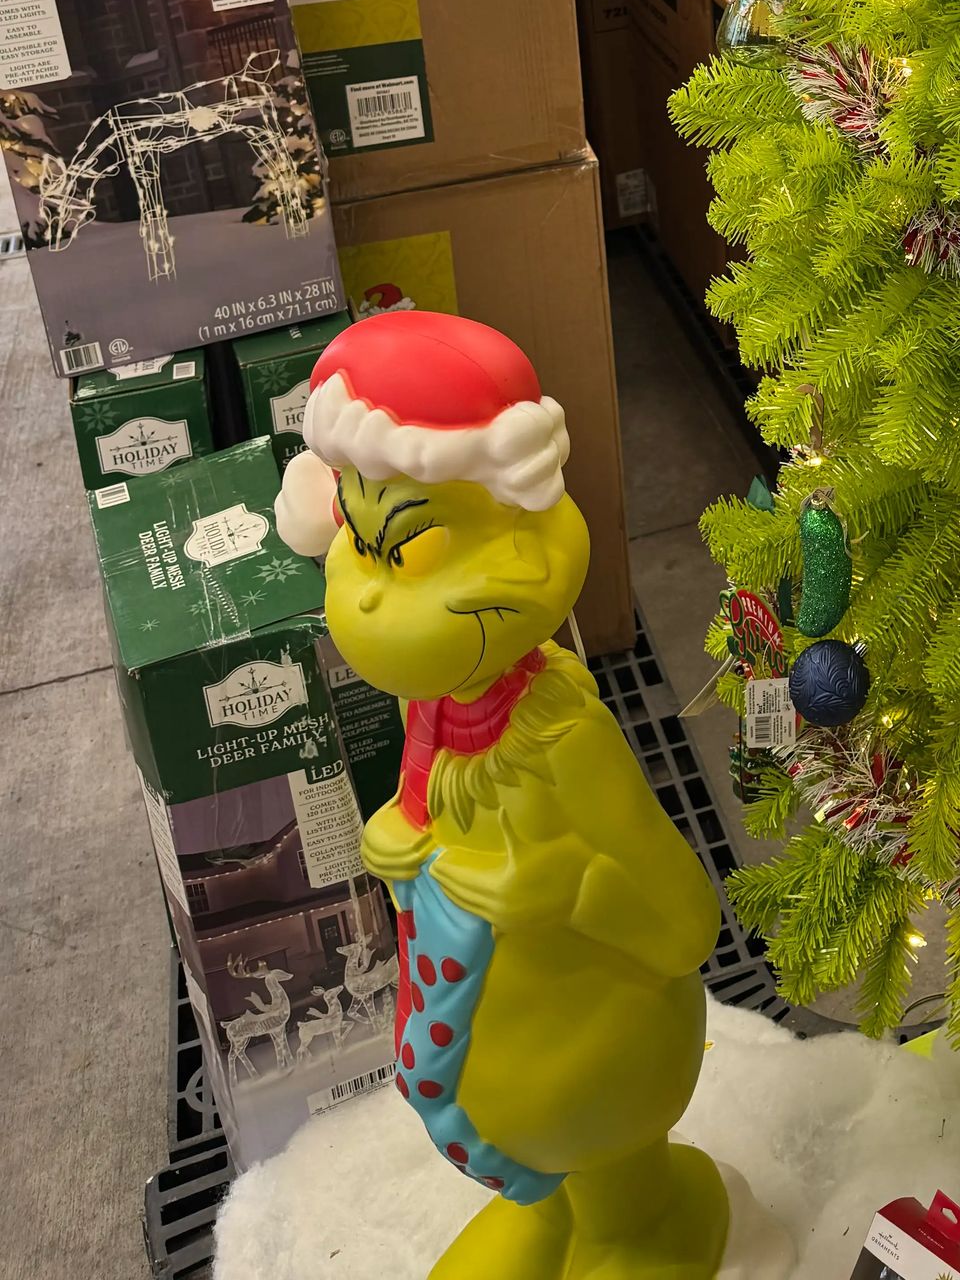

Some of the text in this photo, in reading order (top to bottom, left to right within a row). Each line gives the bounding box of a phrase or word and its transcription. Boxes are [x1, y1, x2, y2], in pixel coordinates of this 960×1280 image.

[20, 10, 46, 18] LIGHTS
[5, 30, 42, 40] ASSEMBLE
[0, 42, 42, 54] OLLAPSIBLE
[1, 47, 54, 60] EASY STORAGE
[5, 65, 59, 79] PRE-ATTACHED
[10, 64, 36, 72] LIGHTS
[36, 72, 59, 81] FRAME
[214, 306, 230, 320] 40
[232, 302, 246, 316] IN
[248, 302, 256, 312] x
[257, 294, 277, 310] 6.3
[279, 290, 292, 304] IN
[294, 290, 302, 301] x
[304, 283, 320, 299] 28
[321, 280, 335, 295] IN
[198, 294, 338, 341] (1 m x 16 cm x 71.1 cm)
[112, 442, 178, 465] HOLIDAY
[131, 457, 164, 470] TIME
[138, 530, 168, 590] DEER FAMILY
[153, 520, 186, 591] LIGHT-UP MESH
[741, 596, 780, 645] PREMIUM
[335, 667, 358, 682] LE
[222, 688, 292, 717] HOLIDAY
[242, 705, 278, 720] TIME
[341, 721, 360, 731] ABLE
[342, 723, 379, 738] CULPTURE
[197, 713, 329, 760] LIGHT-UP MESH
[210, 729, 322, 768] DEER FAMILY
[311, 759, 344, 781] LED
[299, 787, 315, 796] FOR
[305, 785, 341, 800] OUTDOOR
[307, 798, 353, 818] 120 LED LIGH
[310, 792, 352, 811] COMES WIT
[306, 815, 357, 836] LISTED ADAP
[316, 816, 337, 827] WITH
[307, 835, 338, 848] EASY TO
[316, 844, 361, 862] EASY STOR
[319, 861, 364, 879] PRE-ATTAC
[324, 858, 353, 871] LIGHTS
[320, 874, 332, 884] TO
[871, 1236, 900, 1260] ORNAMENTS
